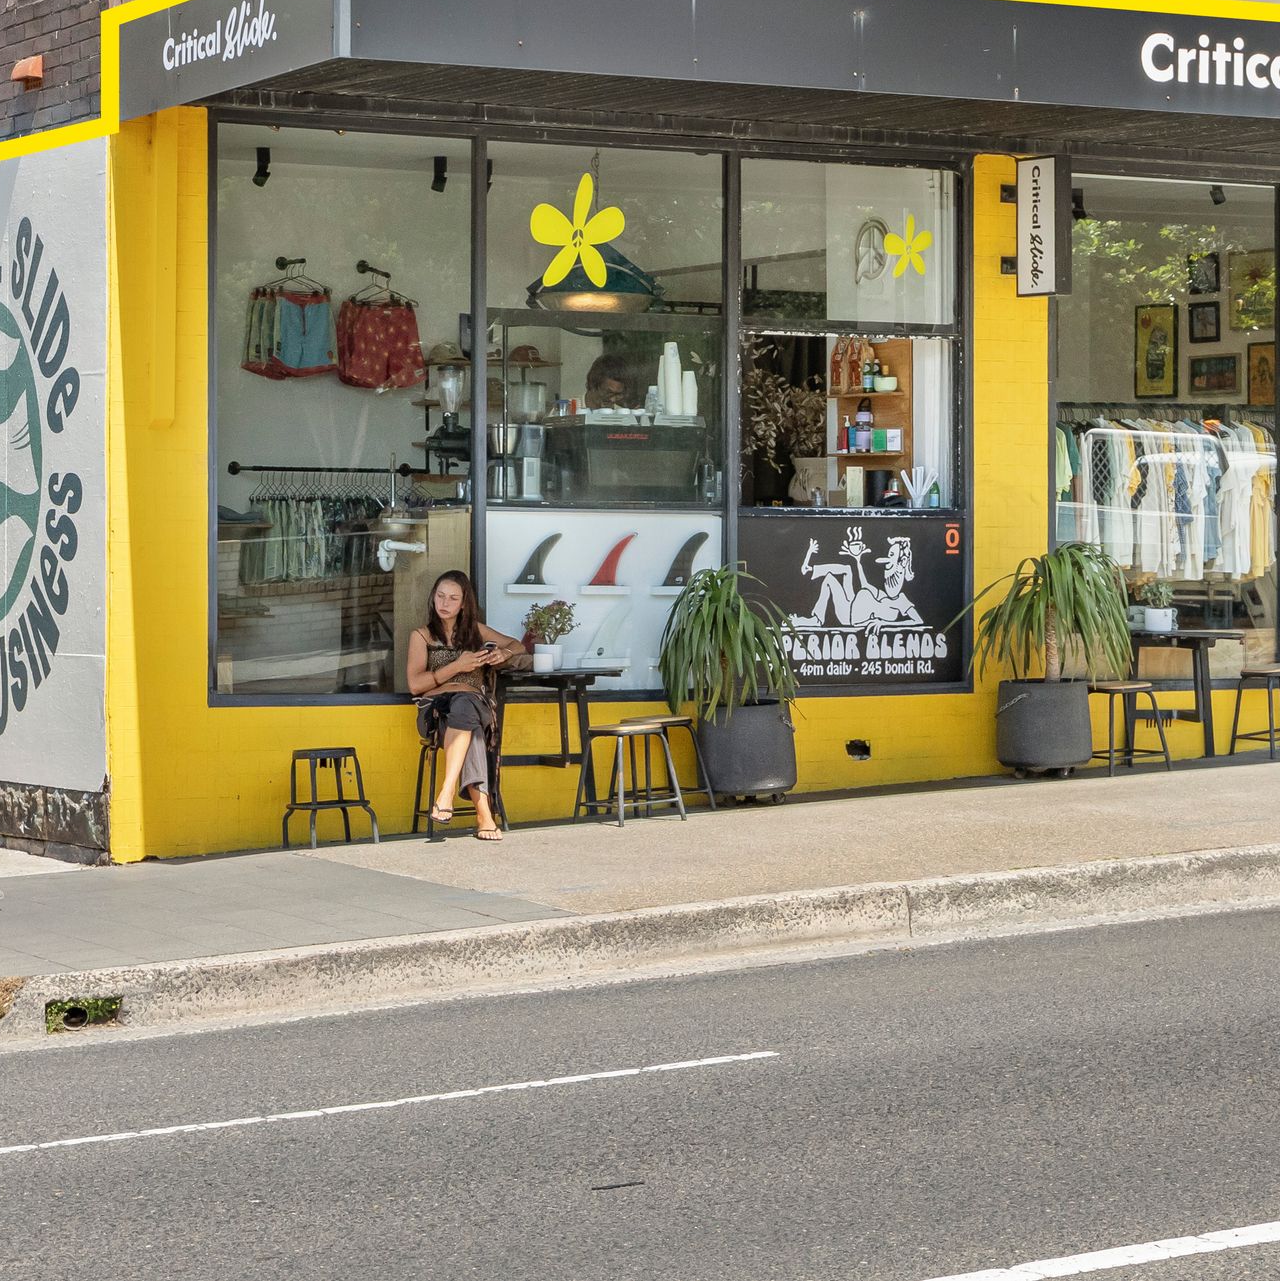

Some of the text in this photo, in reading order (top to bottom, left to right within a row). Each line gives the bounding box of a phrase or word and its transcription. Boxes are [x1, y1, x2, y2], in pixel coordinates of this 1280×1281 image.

[162, 19, 221, 71] Critical
[1032, 165, 1041, 229] Critical
[756, 633, 947, 661] PERIOR BLENDS
[799, 662, 824, 676] 4pm
[826, 661, 852, 676] daily
[861, 662, 882, 675] 245
[884, 660, 914, 674] bondi
[917, 660, 935, 674] Rd.
